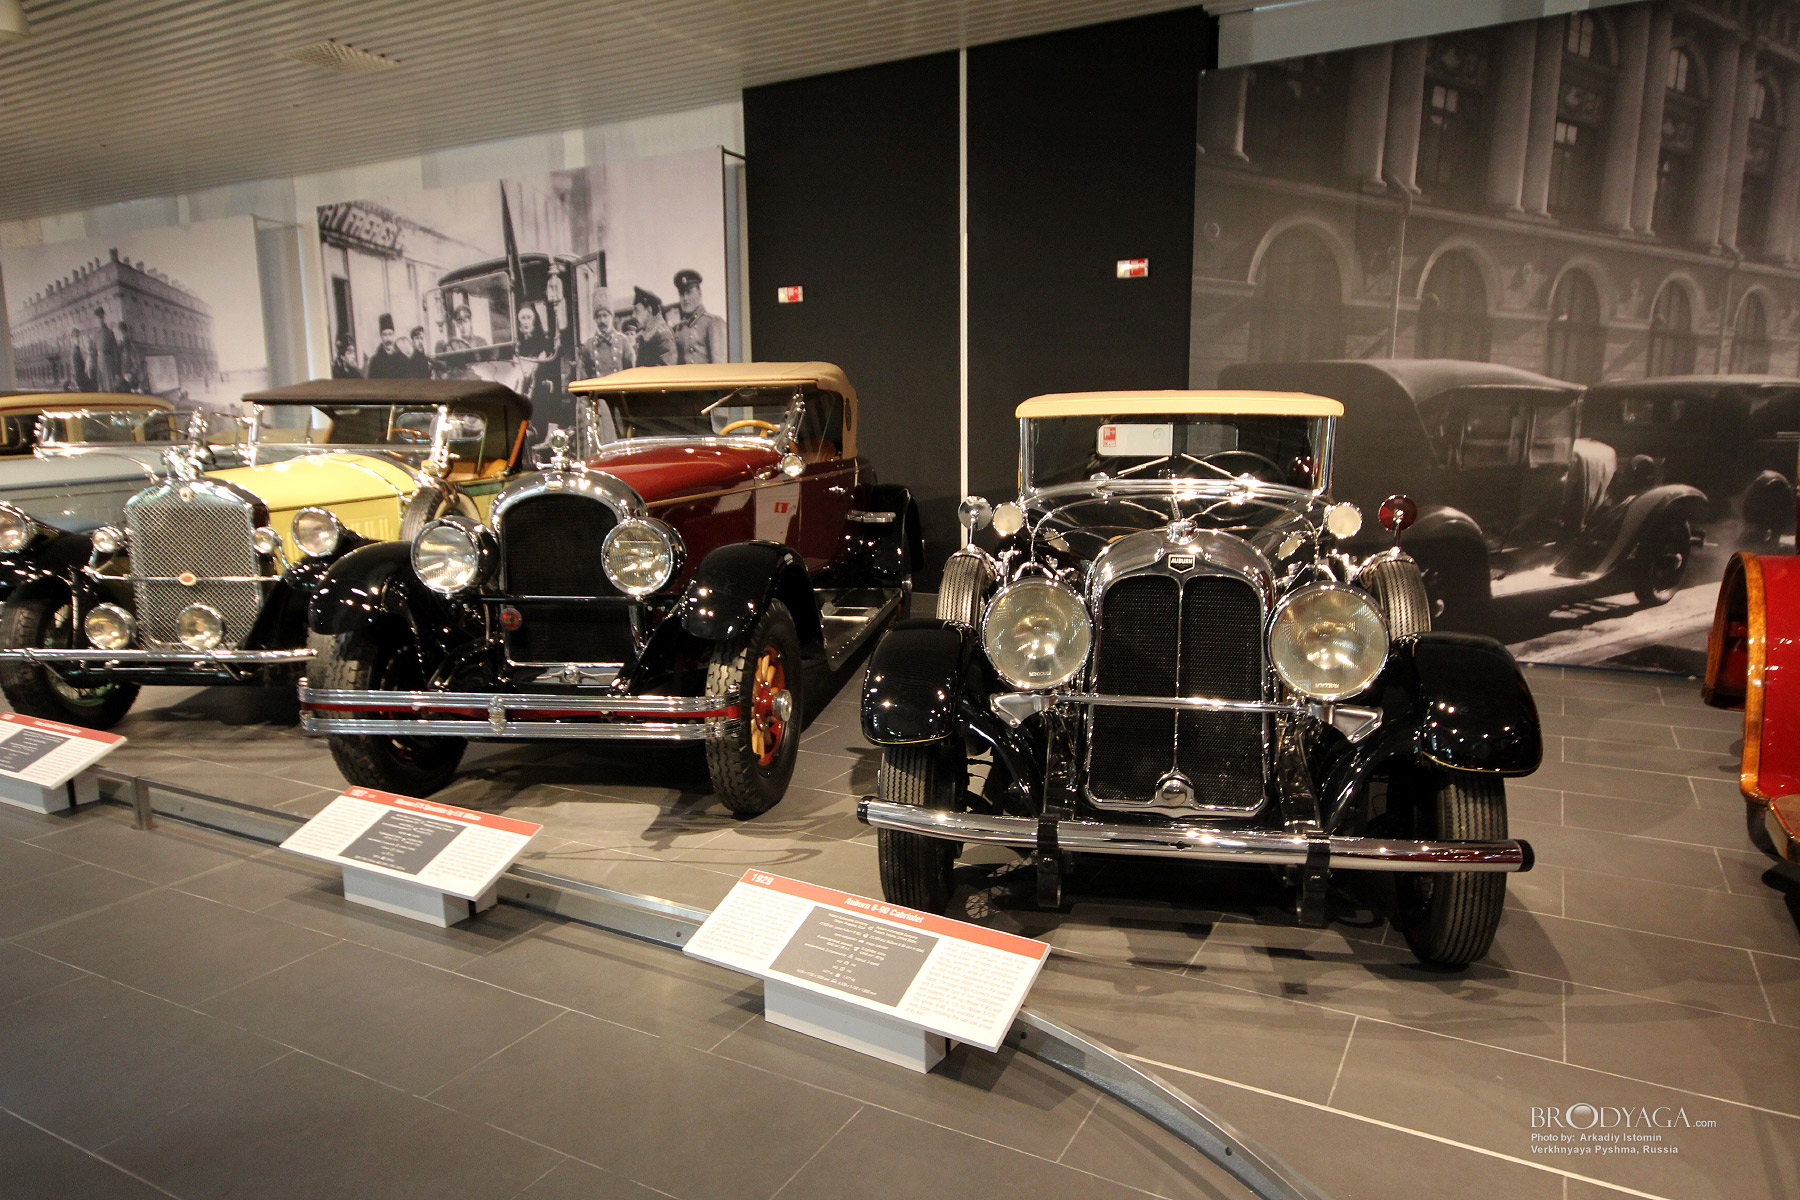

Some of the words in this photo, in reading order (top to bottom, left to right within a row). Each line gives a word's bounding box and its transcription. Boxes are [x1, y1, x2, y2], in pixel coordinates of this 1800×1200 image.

[751, 873, 775, 886] 1929
[843, 897, 872, 911] Auburn
[871, 904, 891, 916] 8-90
[889, 908, 926, 925] Cabriolet
